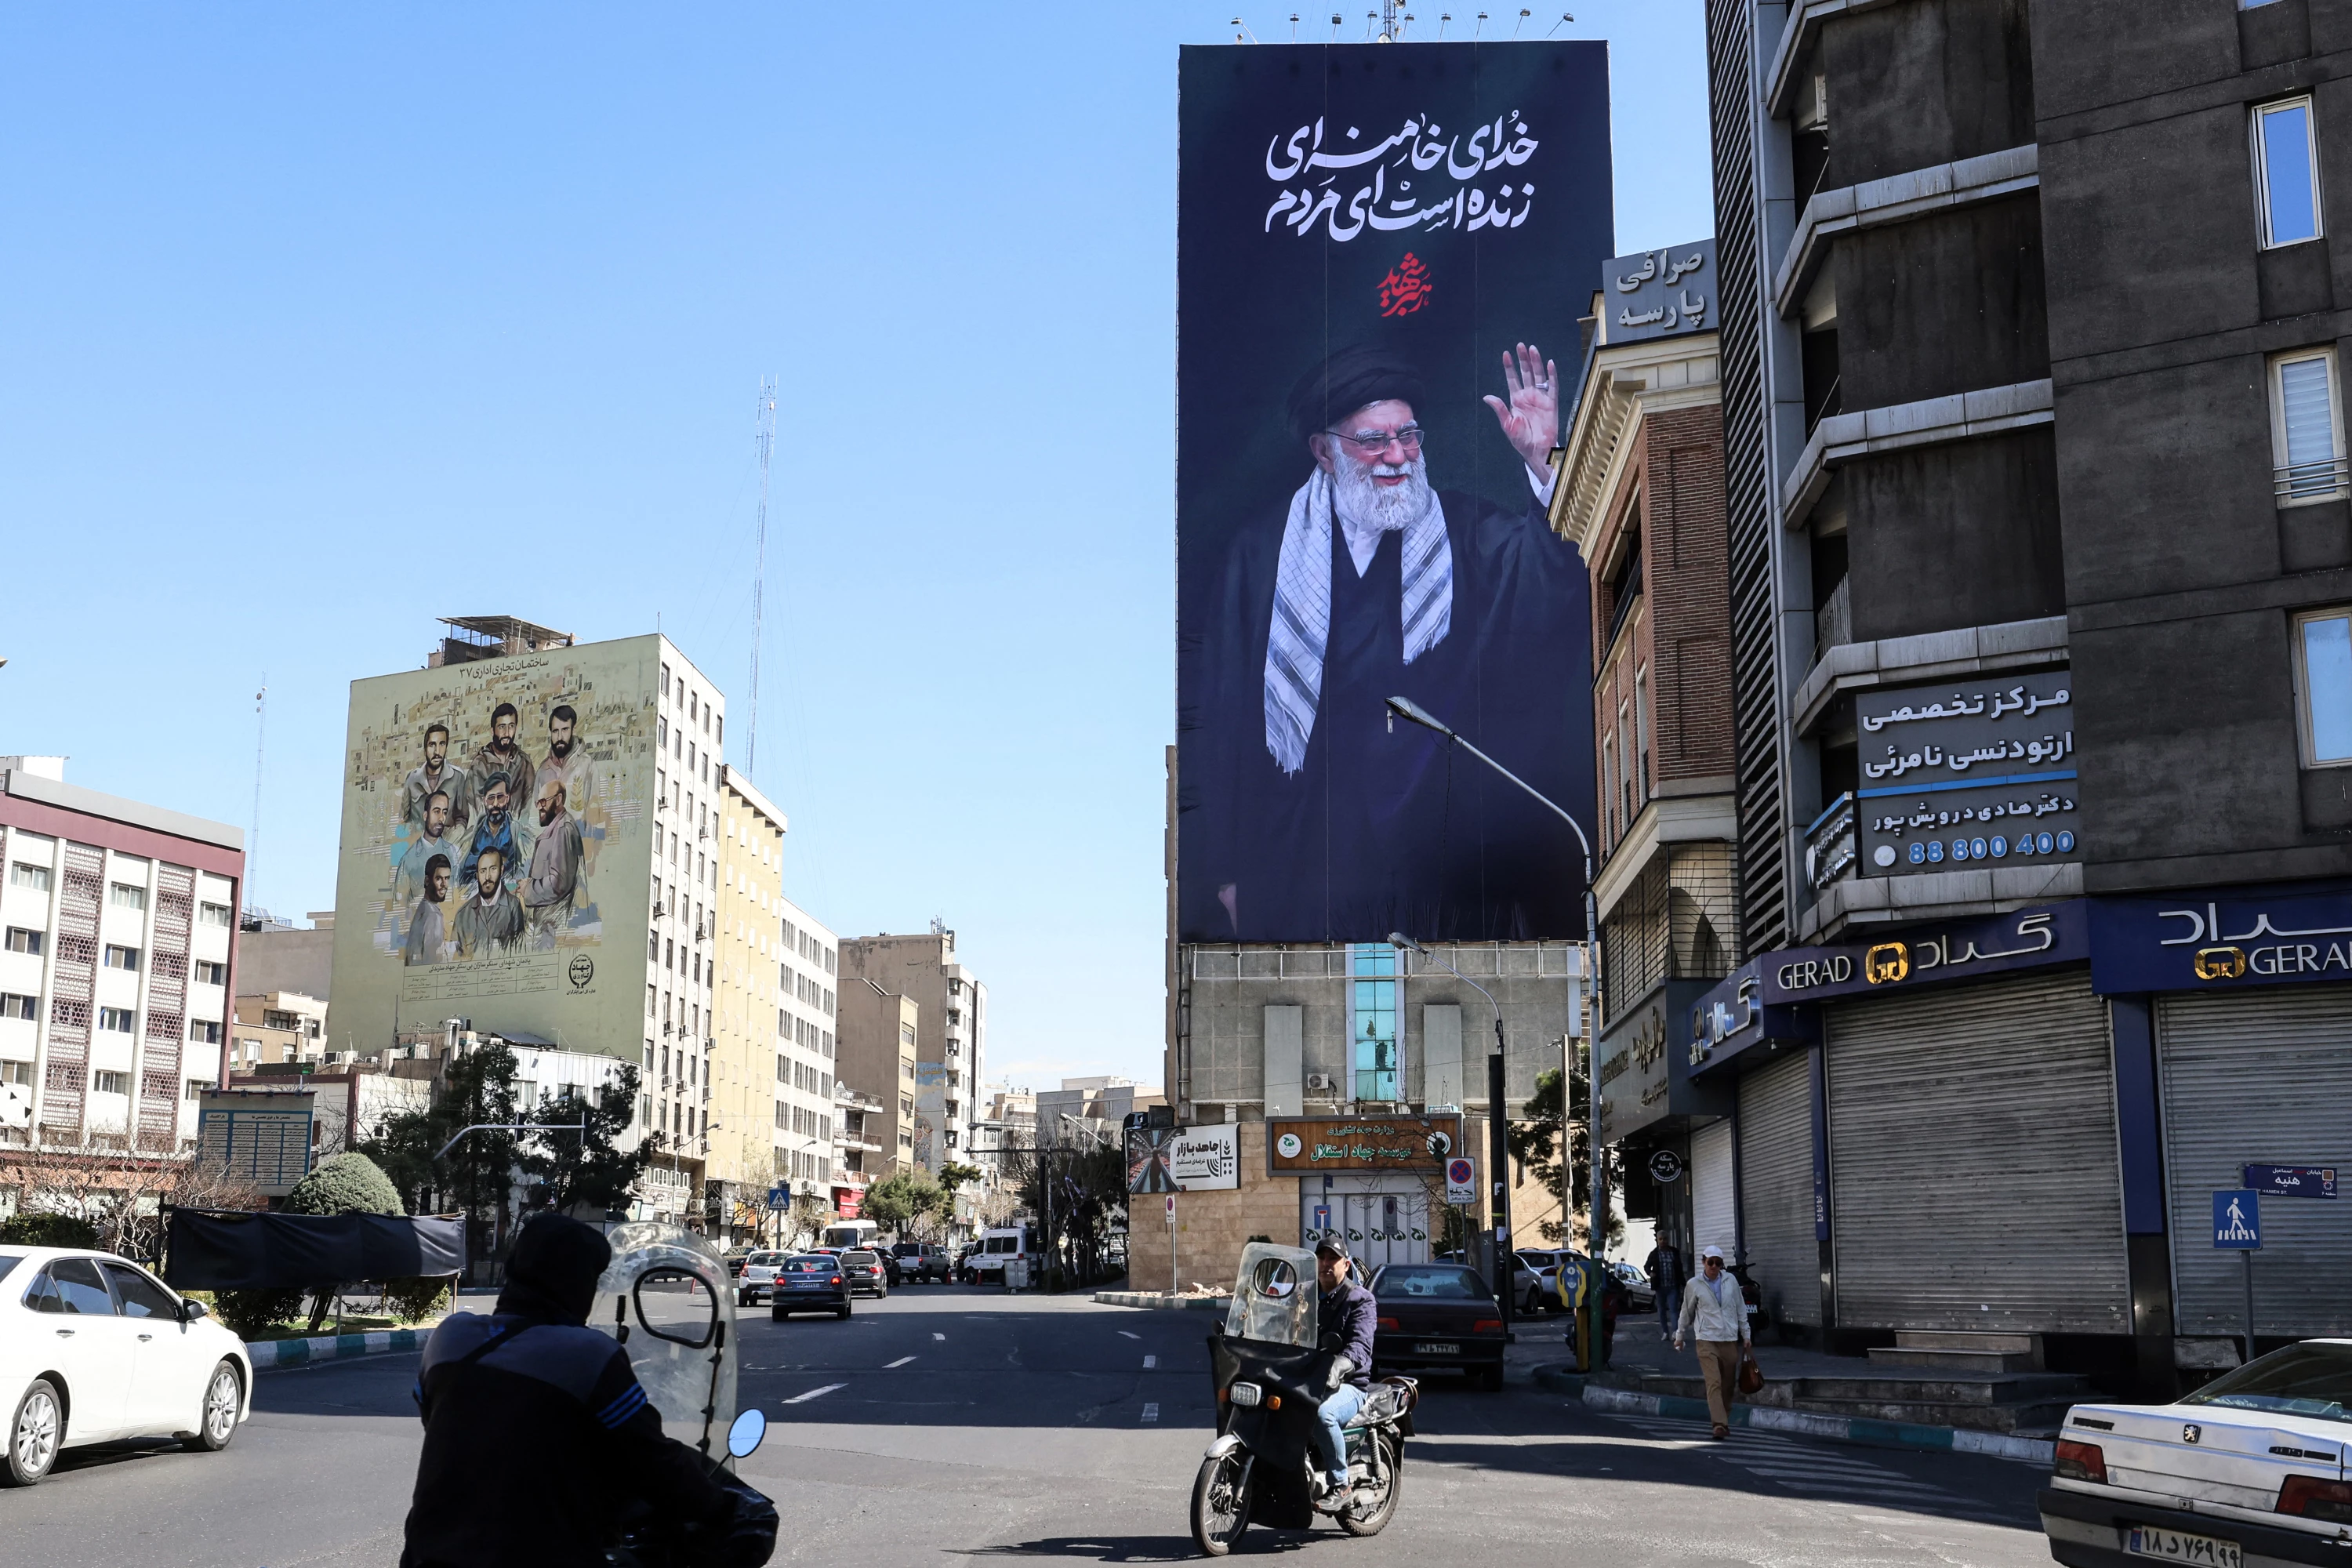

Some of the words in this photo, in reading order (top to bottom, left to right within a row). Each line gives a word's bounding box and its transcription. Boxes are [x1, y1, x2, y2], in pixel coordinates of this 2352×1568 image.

[1329, 164, 1384, 241] ای
[1467, 183, 1535, 231] زنده
[1616, 249, 1702, 291] صرافی
[1618, 289, 1704, 329] پارسه
[472, 664, 492, 679] اداری
[492, 662, 515, 675] تجاری
[515, 657, 549, 672] ساختمان
[1863, 693, 1984, 731] تخصصی
[1991, 685, 2070, 719] مرکز
[1865, 745, 1942, 778] نامرئی
[1948, 731, 2074, 771] ارتودنسی
[1978, 801, 2031, 821] هادی
[2035, 793, 2074, 816] دکتر
[1908, 841, 1944, 865] 88
[1952, 836, 2007, 861] 800
[2016, 830, 2074, 855] 400
[2158, 902, 2352, 946] راد
[572, 964, 590, 973] جهاد
[2249, 941, 2352, 975] GERA
[1777, 955, 1851, 990] GERAD
[1327, 1125, 1357, 1135] کشاورزی
[1357, 1126, 1373, 1134] جهاد
[1374, 1126, 1395, 1135] وزارت
[1177, 1142, 1195, 1158] بازار
[1311, 1143, 1348, 1162] استقلال
[1351, 1145, 1375, 1162] جهاد
[2274, 1176, 2301, 1188] هنیه
